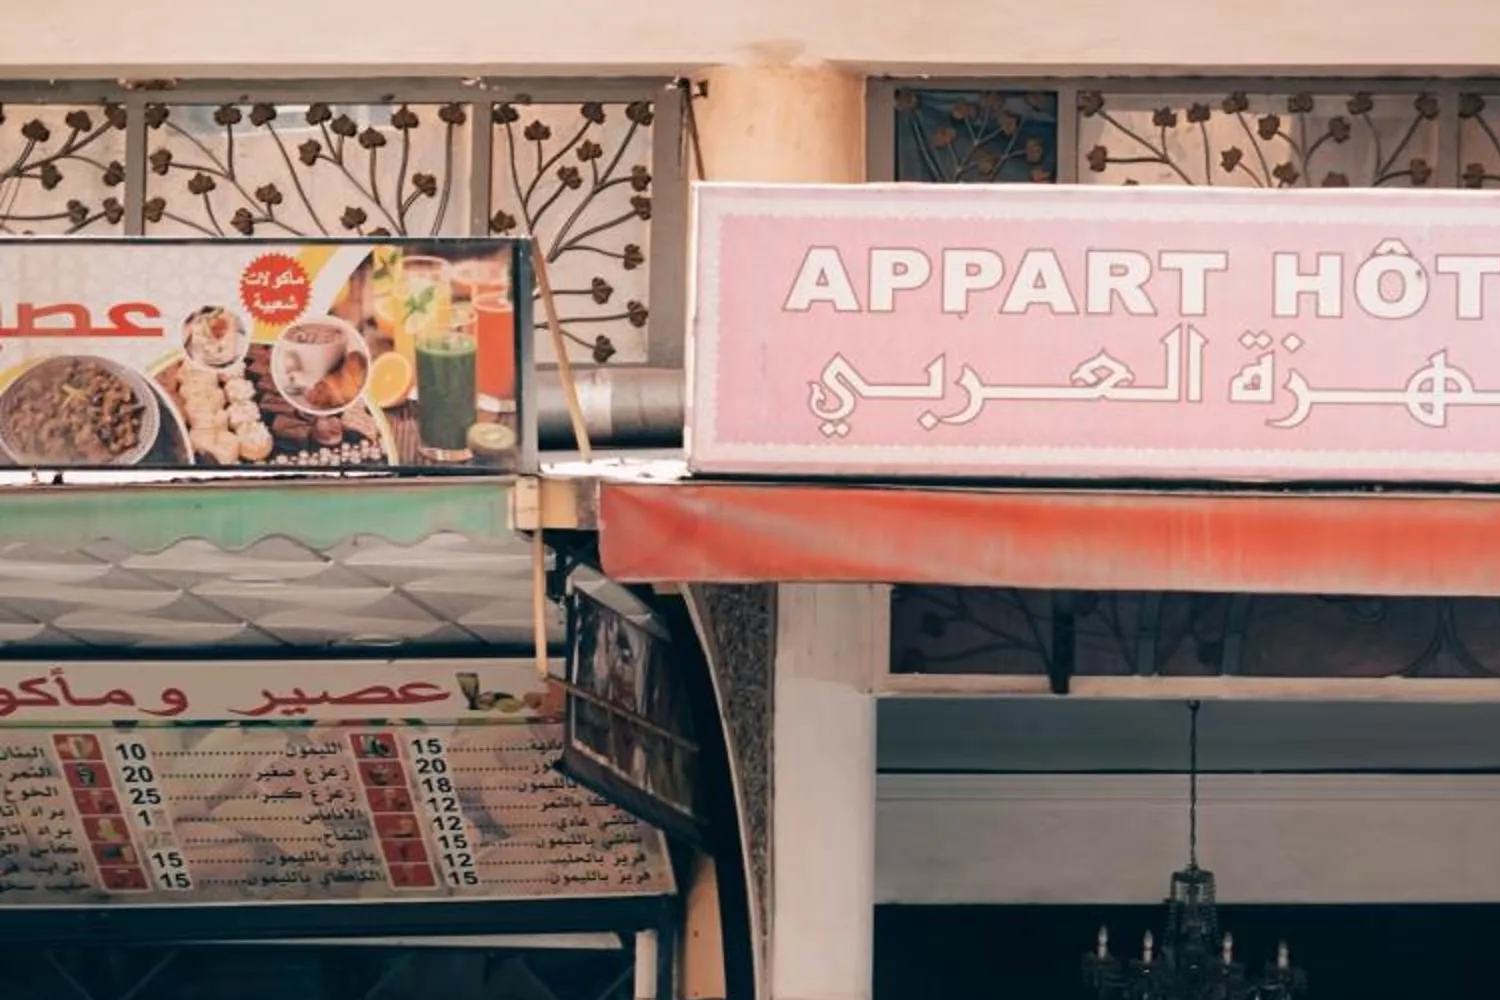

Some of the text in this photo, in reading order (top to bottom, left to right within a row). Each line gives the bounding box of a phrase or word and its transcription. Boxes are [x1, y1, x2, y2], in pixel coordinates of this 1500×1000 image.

[782, 246, 1227, 317] APPART
[0, 302, 163, 338] عص
[807, 322, 1208, 438] العربي
[228, 681, 450, 716] عصير
[116, 743, 147, 761] 10
[411, 739, 442, 755] 15
[416, 758, 447, 774] 20
[122, 766, 154, 783] 20
[423, 777, 453, 793] 18
[129, 788, 161, 805] 25
[427, 797, 459, 812] 12
[433, 815, 463, 831] 12
[438, 834, 468, 849] 15
[152, 852, 183, 869] 15
[443, 853, 473, 868] 12
[160, 873, 191, 889] 15
[448, 870, 479, 886] 15
